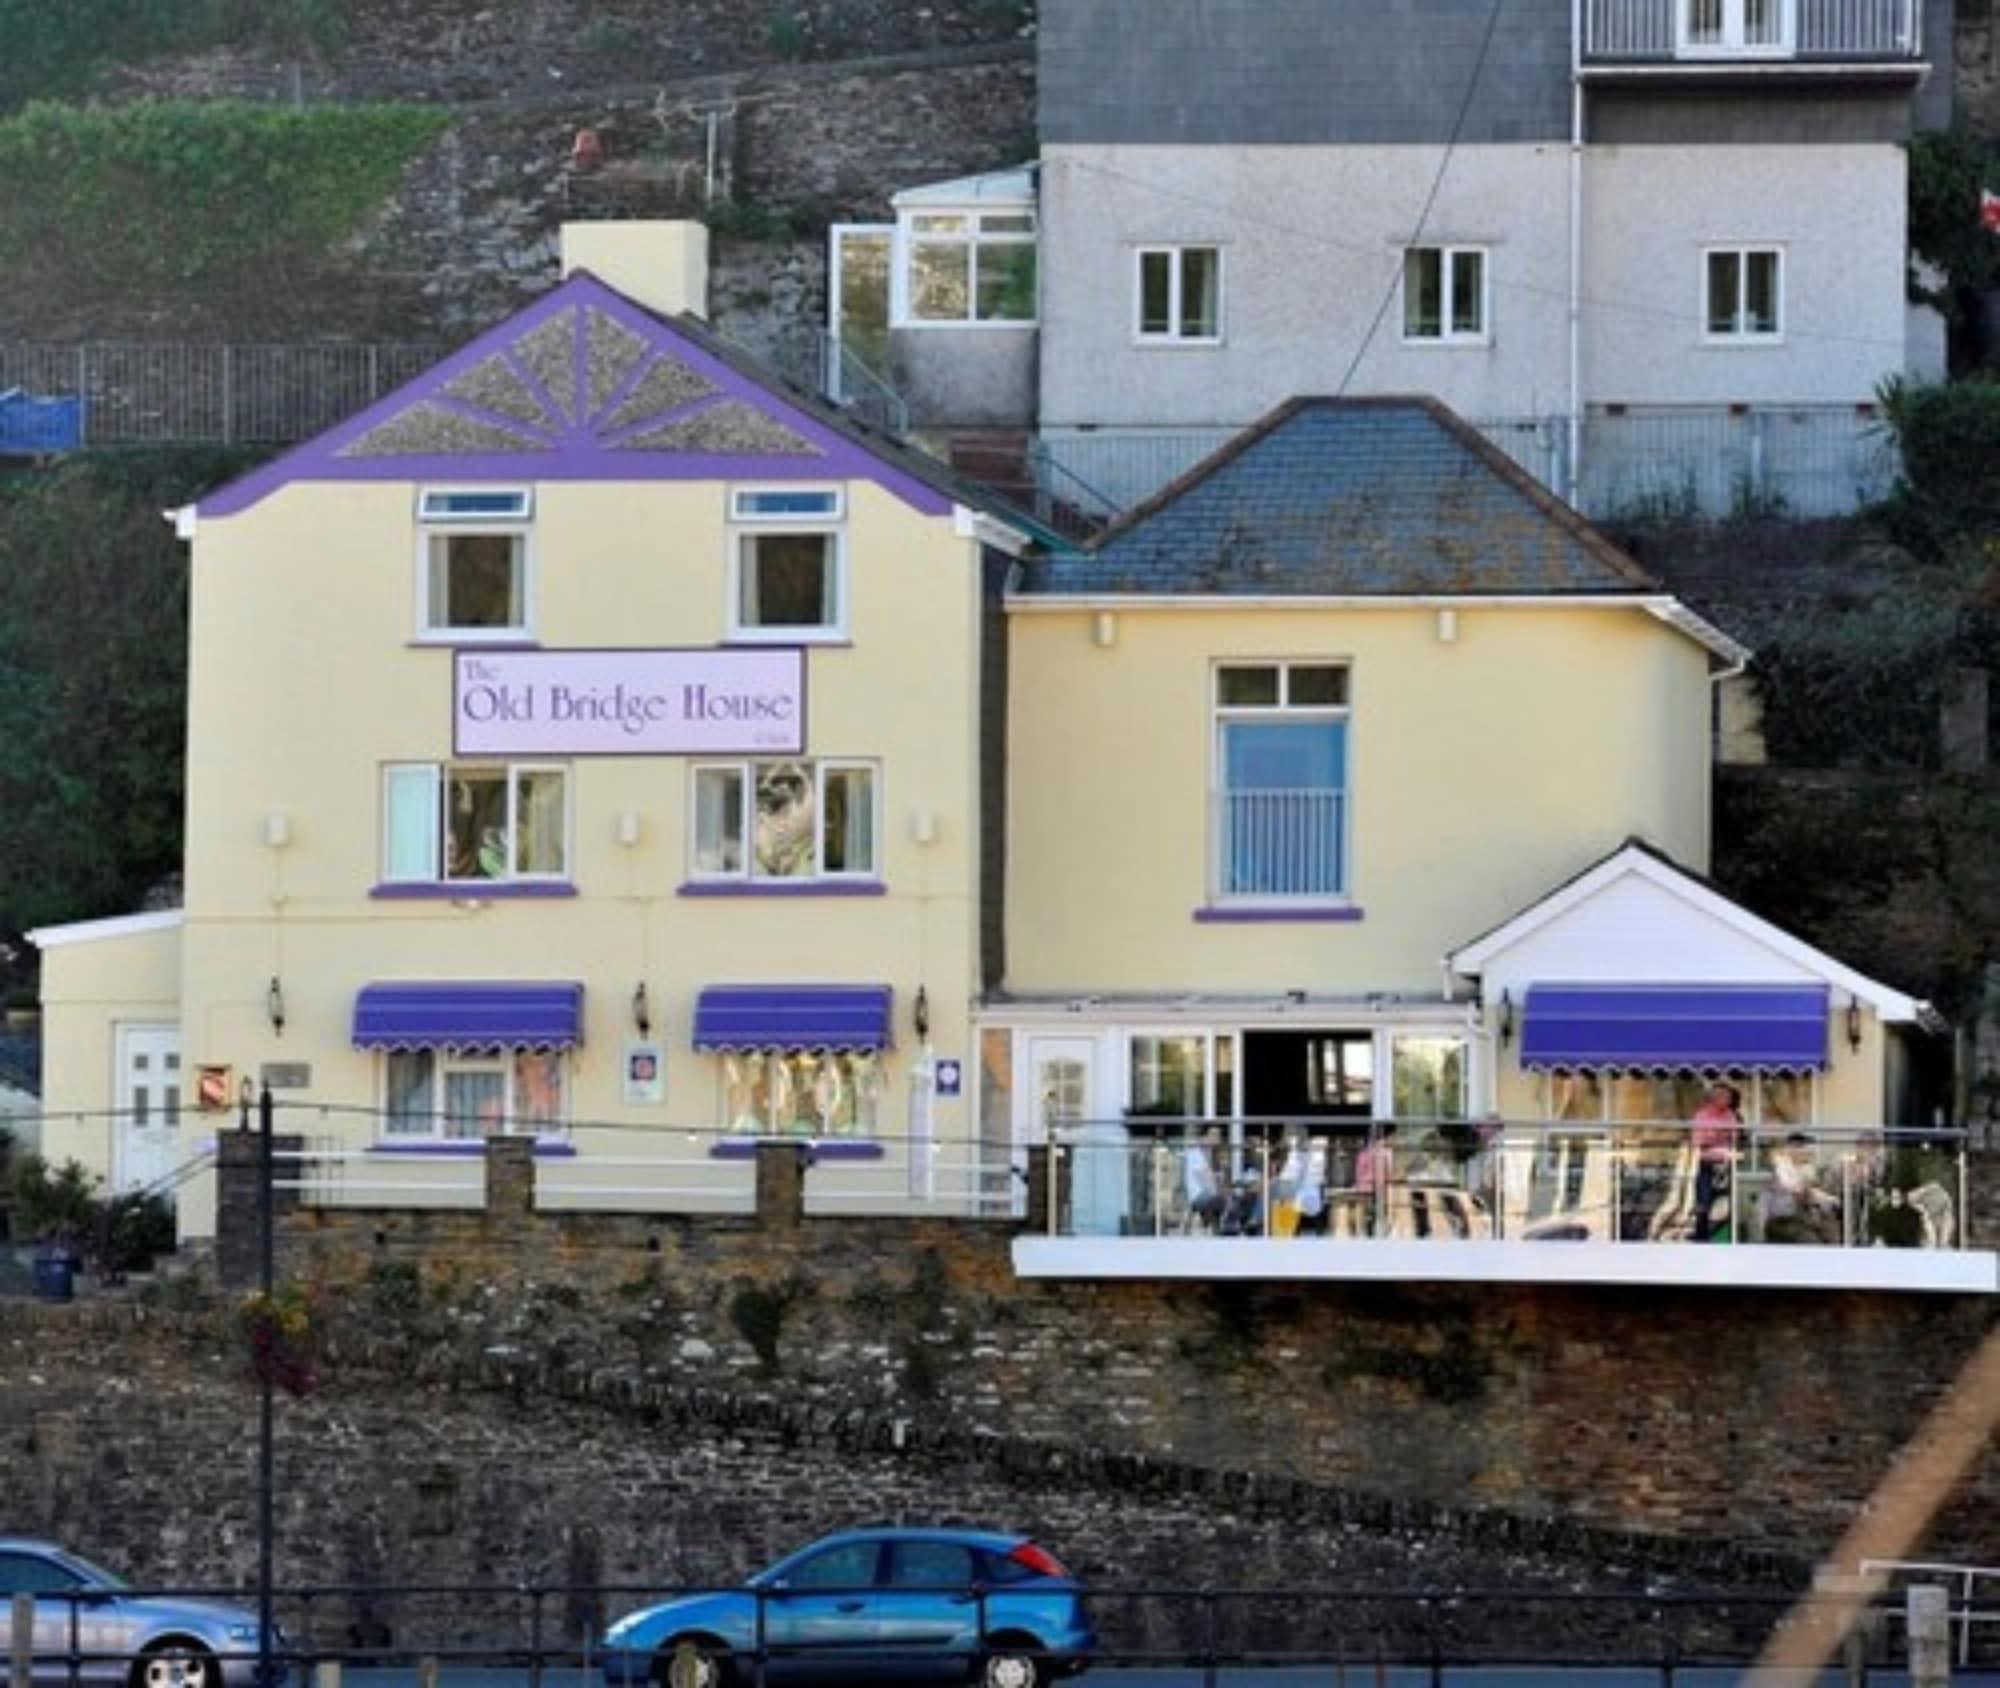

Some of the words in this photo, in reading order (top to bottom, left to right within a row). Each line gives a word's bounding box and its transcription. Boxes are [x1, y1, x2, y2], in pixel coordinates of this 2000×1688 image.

[463, 659, 499, 681] The
[463, 684, 533, 721] Old
[550, 684, 667, 735] Bridge
[684, 684, 794, 721] House
